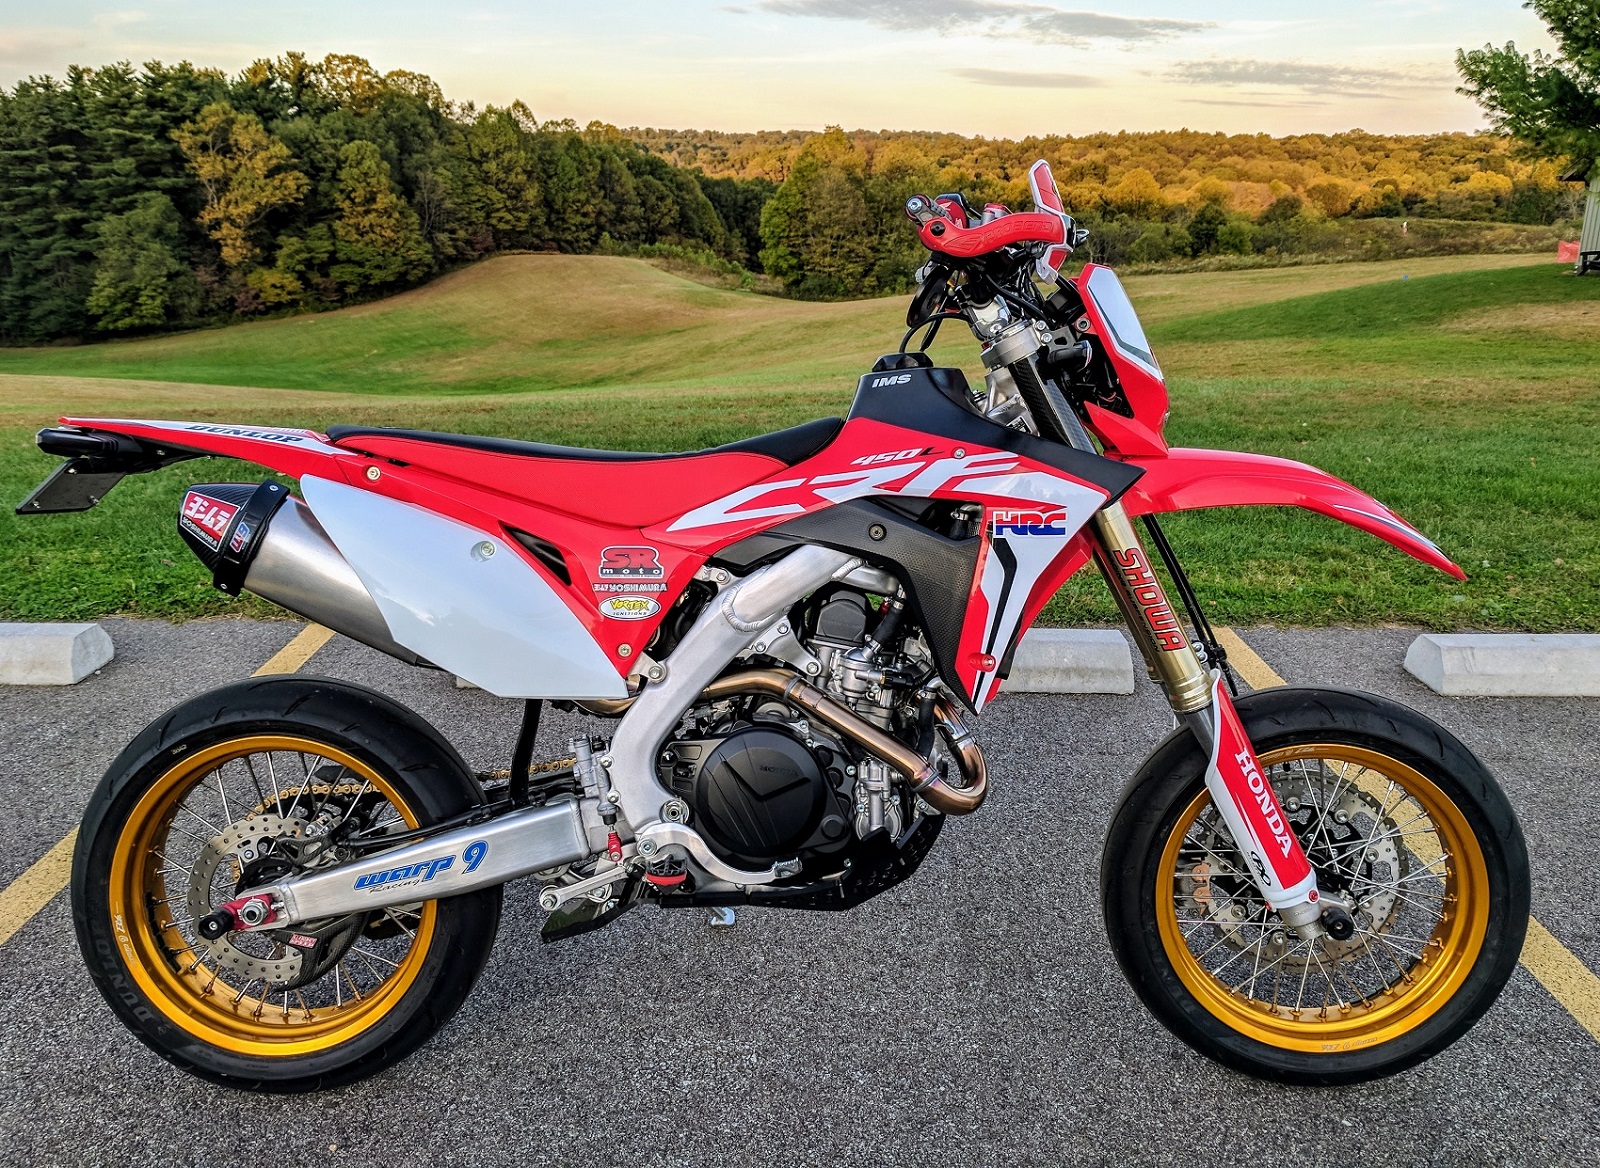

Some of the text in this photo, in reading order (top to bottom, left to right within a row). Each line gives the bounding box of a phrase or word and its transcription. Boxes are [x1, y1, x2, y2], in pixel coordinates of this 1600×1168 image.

[872, 374, 912, 388] IMS
[184, 425, 303, 442] DUNLOP
[182, 516, 219, 548] YOSHIMURA
[994, 511, 1067, 537] HRC
[602, 547, 661, 569] SR
[602, 567, 661, 575] moto
[609, 583, 667, 592] YOSHIMURA
[1113, 547, 1188, 652] SHOWA
[1235, 747, 1293, 859] HONDA
[462, 840, 489, 875] 9
[368, 878, 421, 893] Racing
